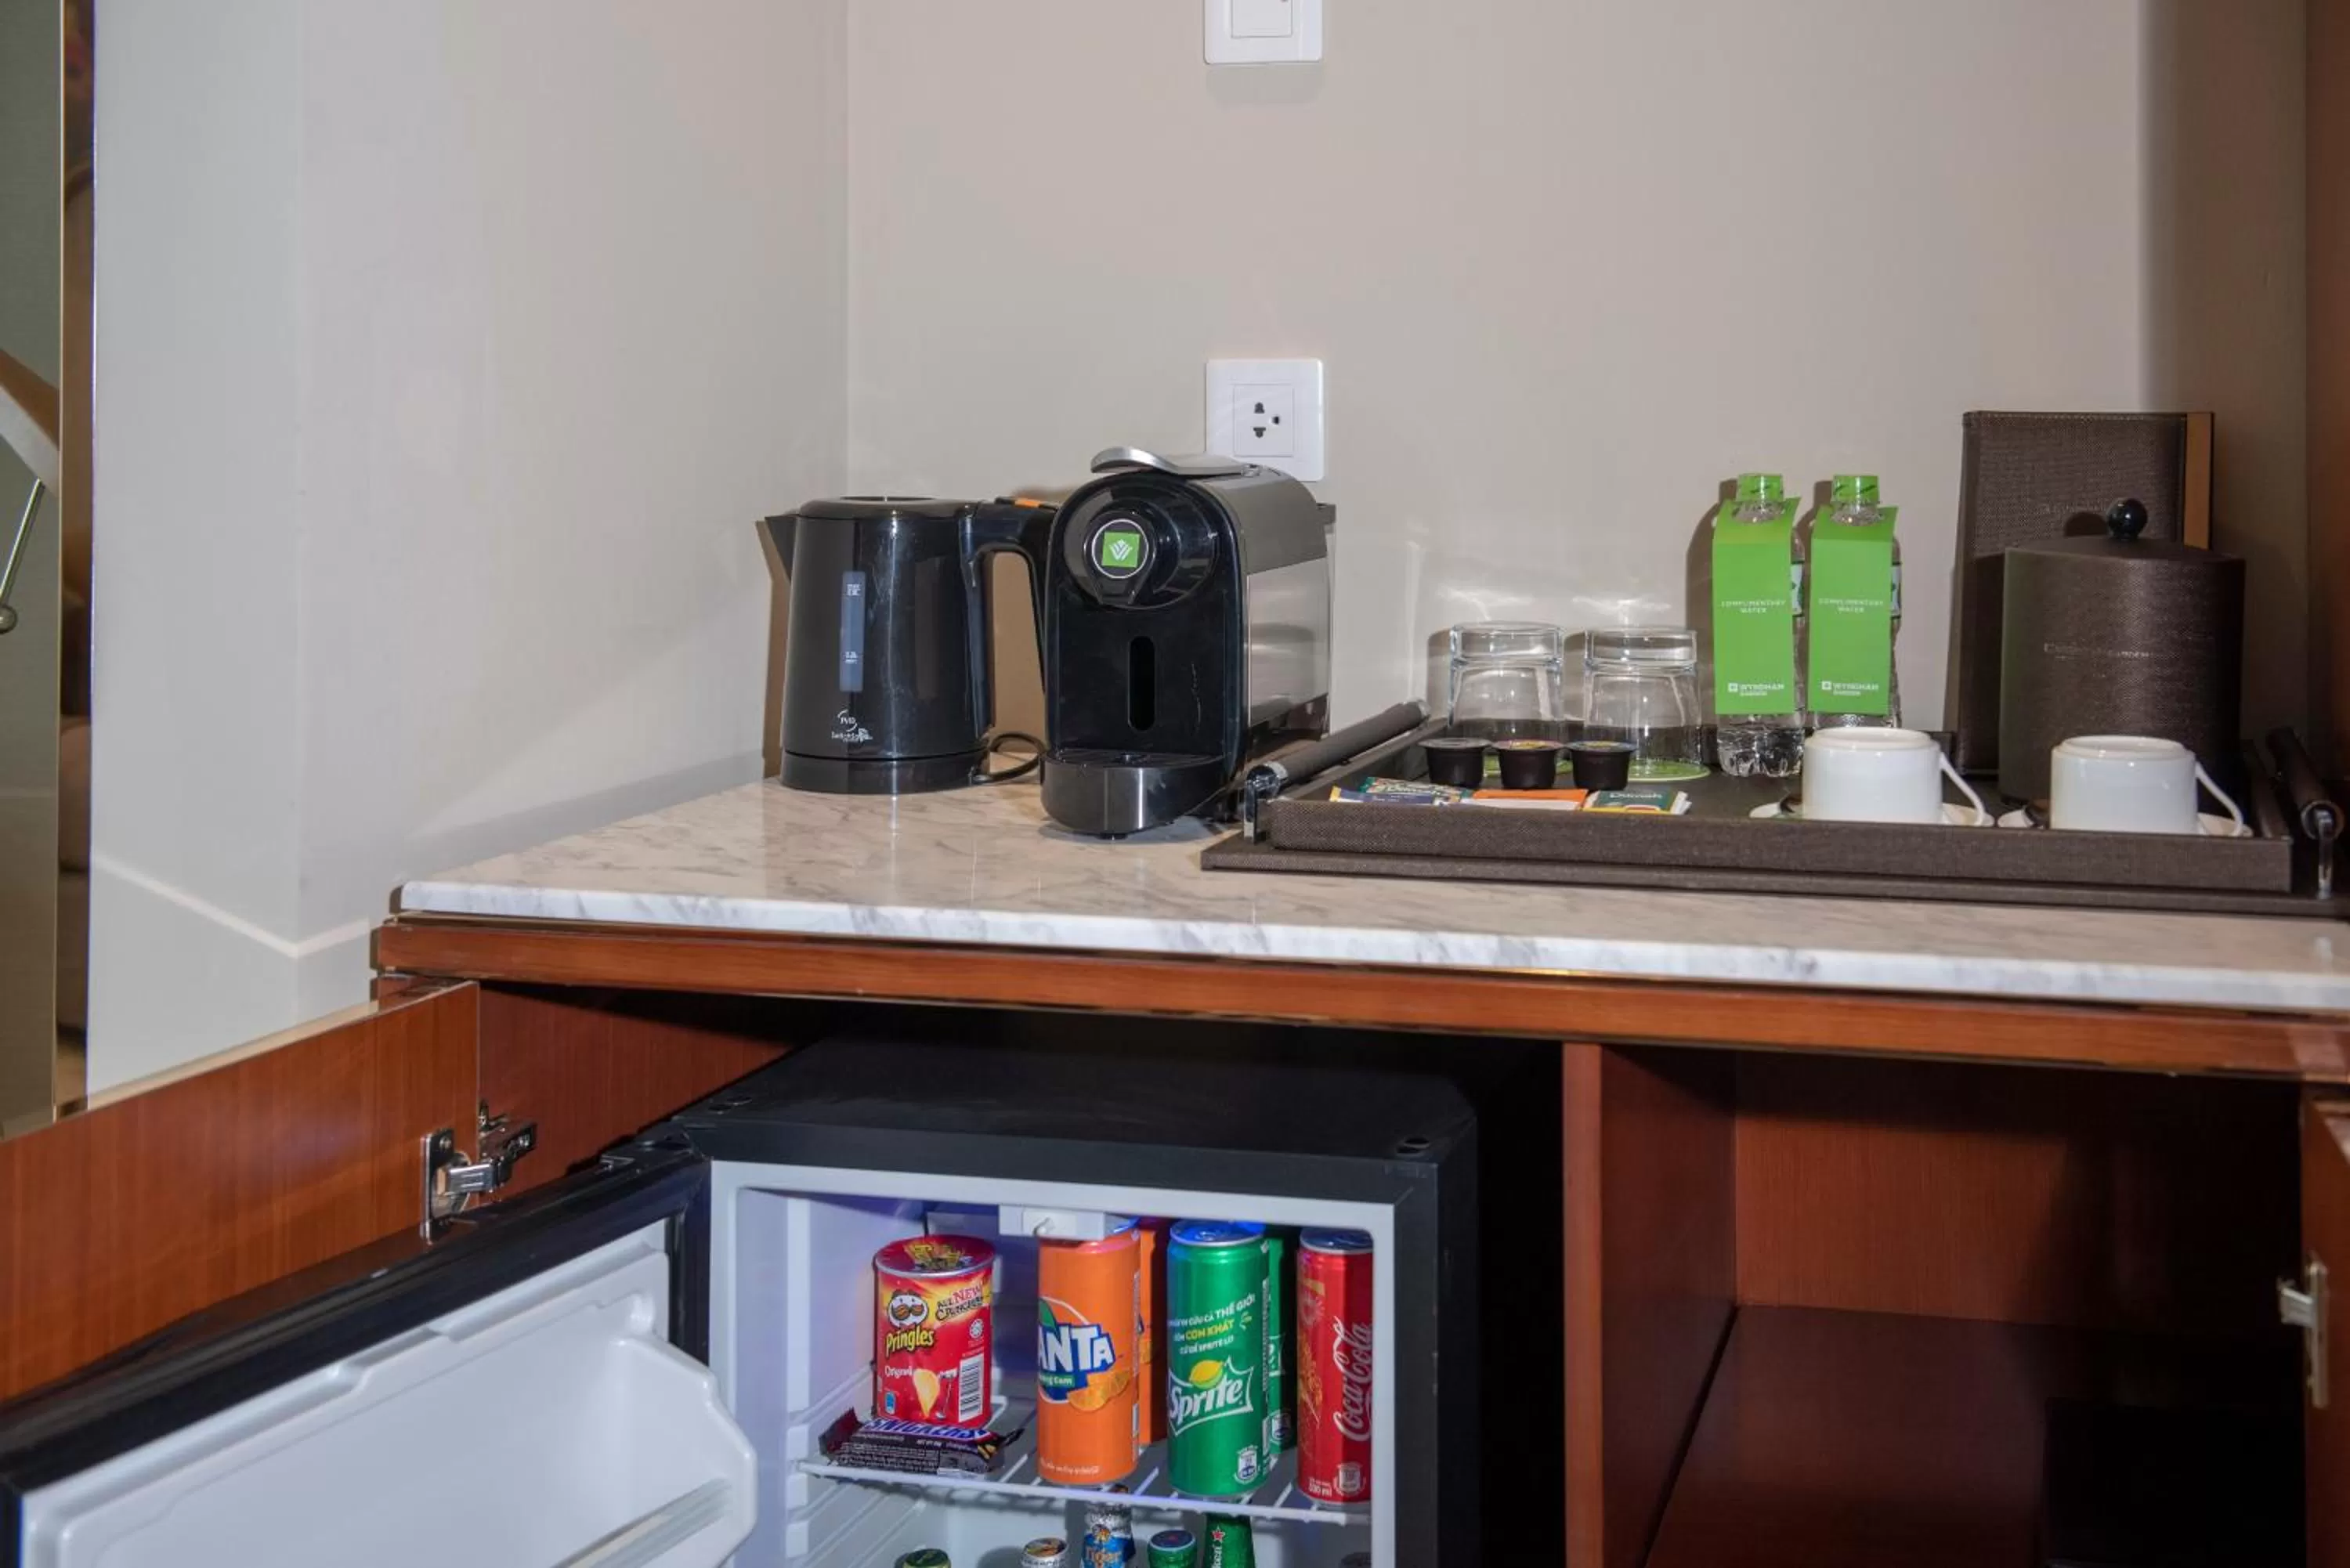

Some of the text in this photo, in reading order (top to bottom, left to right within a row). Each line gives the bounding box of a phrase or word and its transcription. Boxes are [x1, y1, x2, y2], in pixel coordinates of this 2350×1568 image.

[886, 1324, 935, 1357] Pringles
[1039, 1324, 1114, 1372] ANTA
[1169, 1372, 1243, 1425] Sprite
